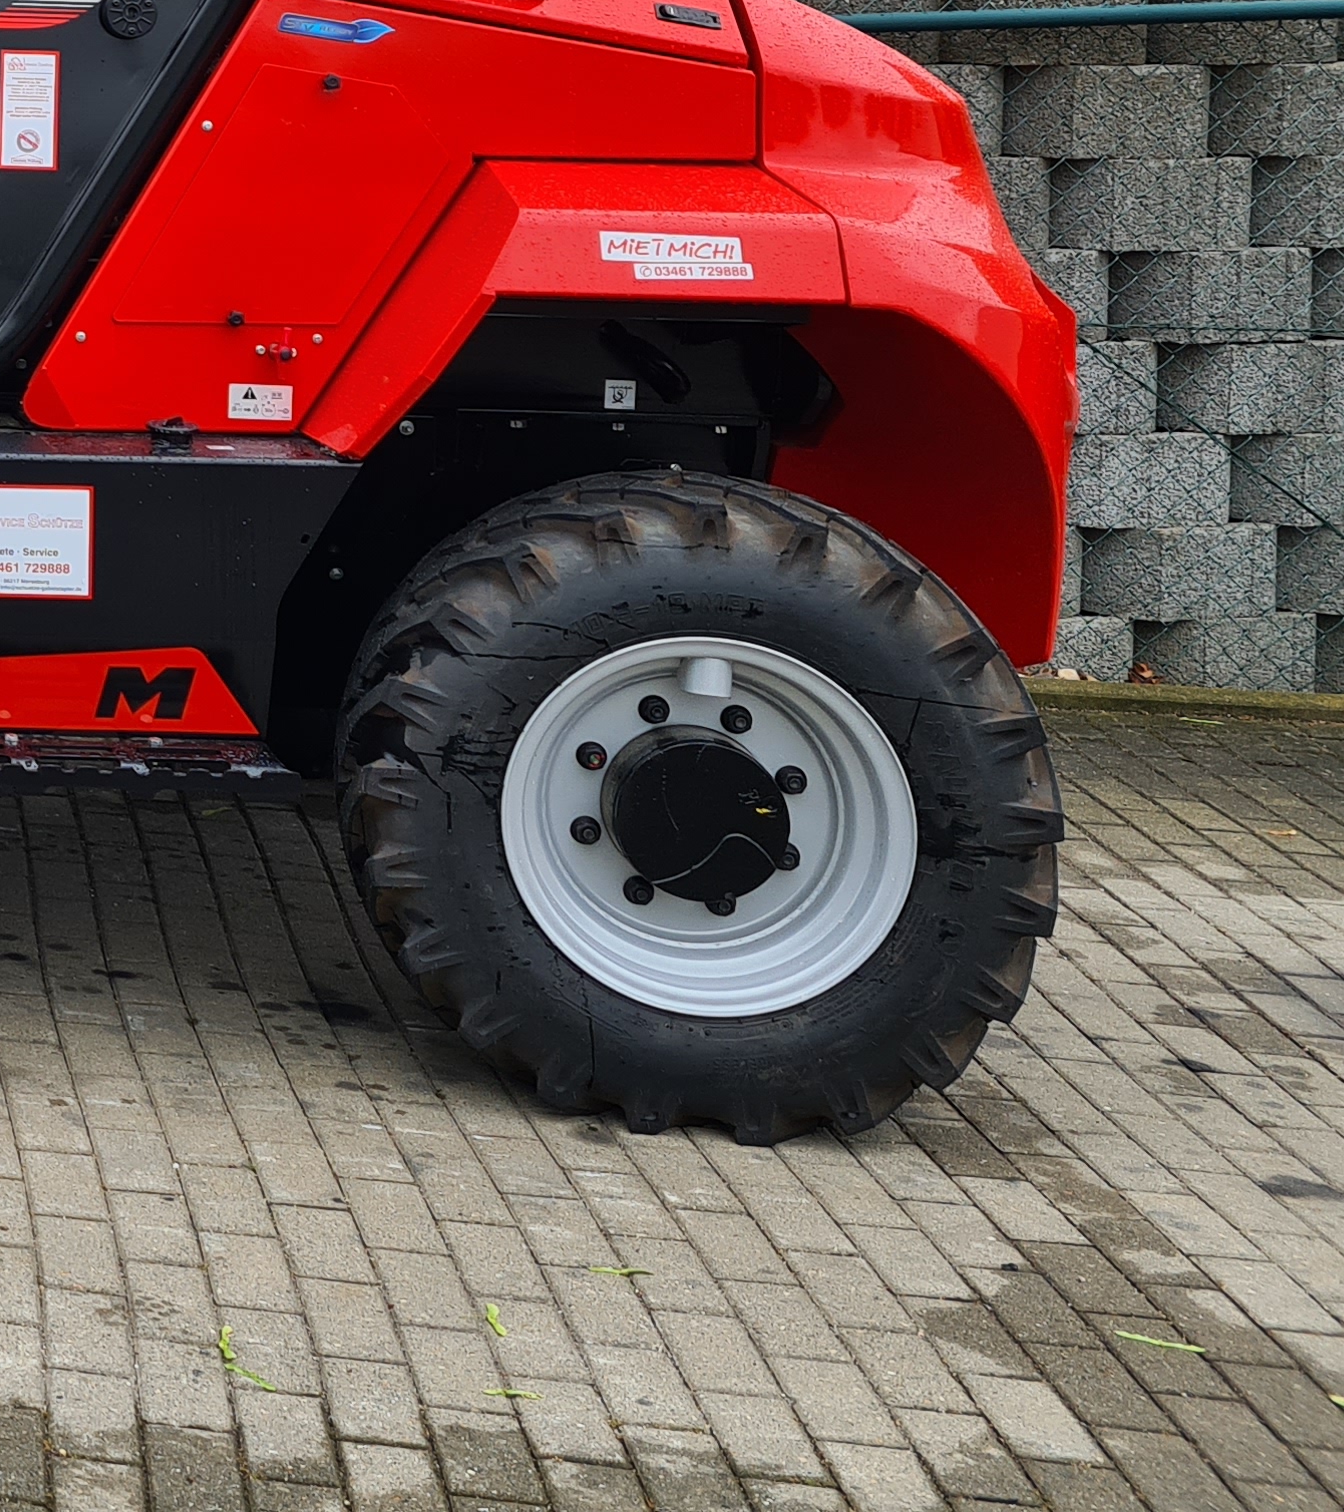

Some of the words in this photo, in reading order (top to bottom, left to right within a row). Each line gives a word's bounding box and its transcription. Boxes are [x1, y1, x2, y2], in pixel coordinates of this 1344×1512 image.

[654, 266, 694, 277] 03461
[699, 266, 748, 277] 729888
[22, 548, 59, 557] Service
[24, 563, 70, 574] 729888
[95, 667, 197, 720] M
